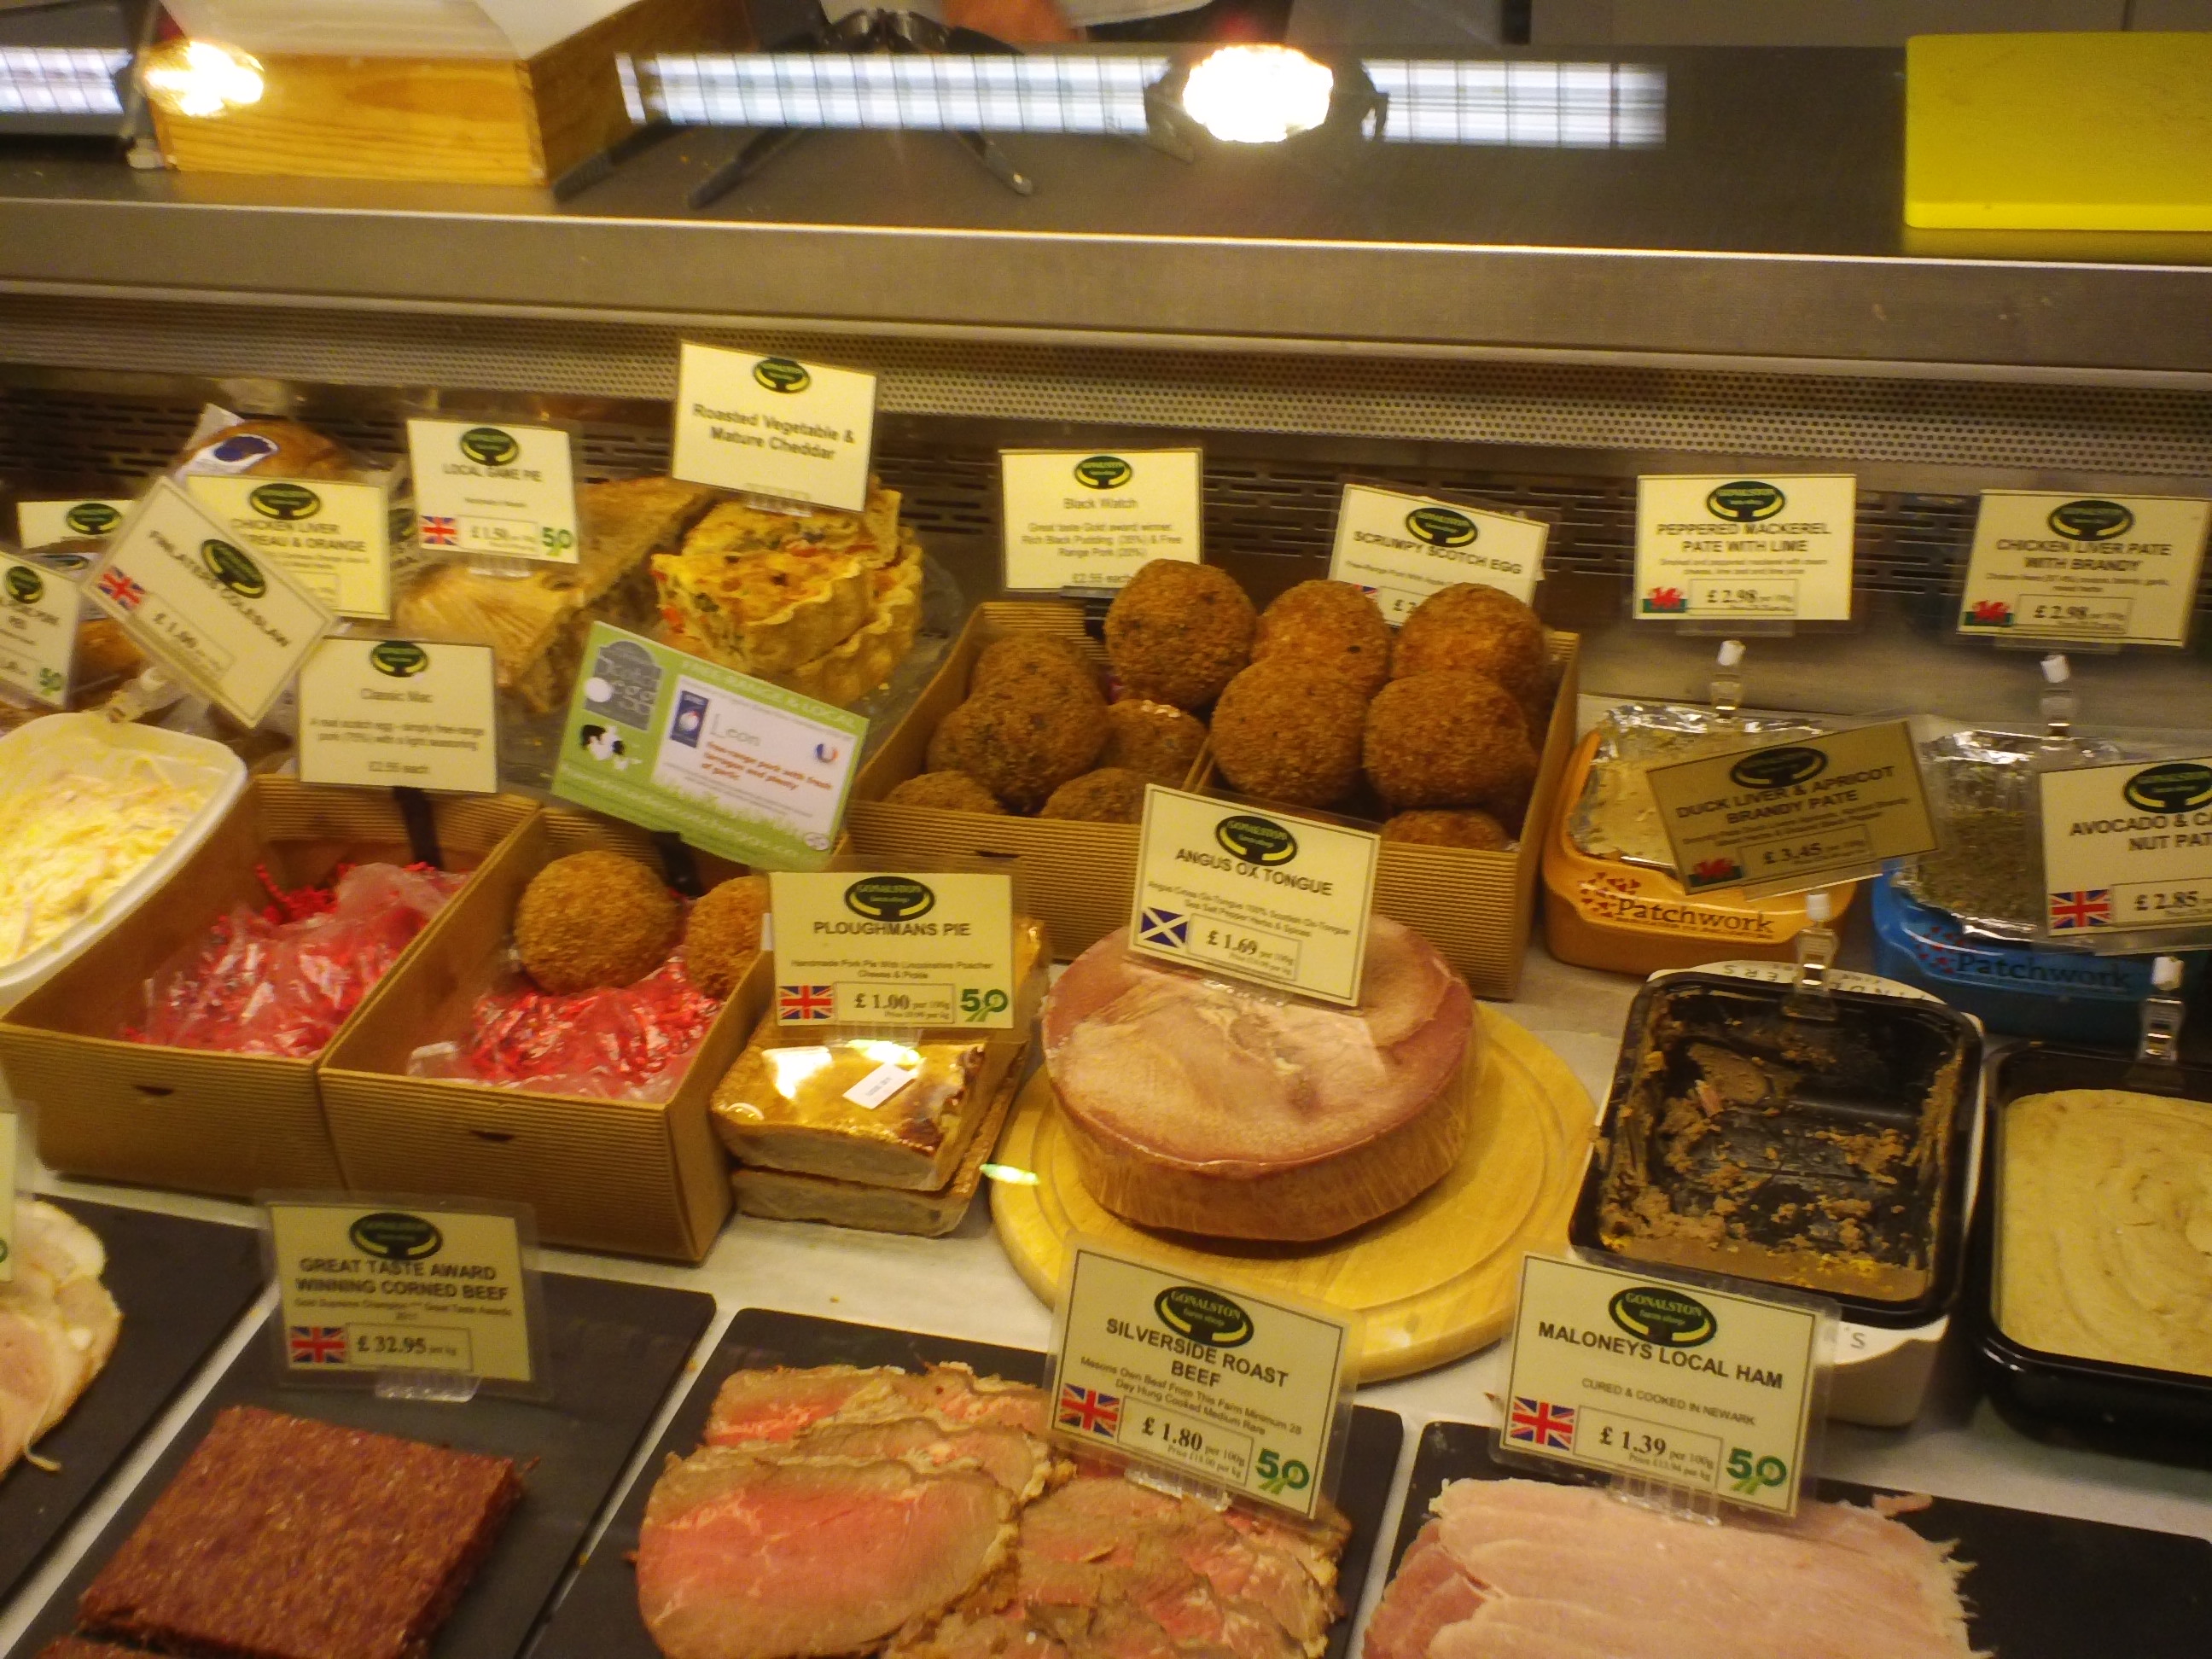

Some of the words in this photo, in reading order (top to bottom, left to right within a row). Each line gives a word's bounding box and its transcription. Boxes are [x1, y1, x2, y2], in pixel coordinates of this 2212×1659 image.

[694, 404, 759, 426] Roasted
[763, 415, 839, 440] Vegetable
[844, 429, 855, 443] &
[711, 426, 765, 447] Mature
[770, 436, 835, 459] Cheddar
[1064, 498, 1095, 509] Black
[1100, 498, 1138, 509] Watch
[1657, 523, 1740, 535] PEPPERED
[1744, 522, 1831, 535] MACKEREL
[1353, 531, 1423, 554] SCRUMPY
[1428, 544, 1488, 568] SCOTCH
[1490, 558, 1523, 574] EGG
[1681, 540, 1722, 552] PATE
[1726, 540, 1767, 552] WITH
[1770, 540, 1808, 551] LIME
[1996, 539, 2070, 552] CHICKEN
[2074, 542, 2124, 555] LIVER
[2127, 544, 2173, 556] PATE
[2024, 557, 2068, 569] WITH
[2070, 559, 2144, 571] BRANDY
[1675, 798, 1731, 818] DUCK
[1732, 787, 1791, 806] LIVER
[1795, 783, 1807, 795] &
[1812, 766, 1895, 792] APRICOT
[1726, 801, 1802, 824] BRANDY
[1808, 789, 1858, 810] PATE
[2070, 816, 2167, 836] AVOCADO
[2174, 813, 2188, 827] &
[2128, 835, 2170, 851] NUT
[1176, 848, 1231, 872] ANGUS
[1237, 862, 1260, 878] OX
[1263, 865, 1333, 896] TONGUE
[812, 922, 937, 936] PLOUGHMANS
[943, 923, 972, 936] PIE
[1616, 898, 1774, 934] Patchwork
[1208, 930, 1220, 946] £
[1224, 934, 1258, 955] 1.69
[1957, 952, 2130, 989] Patchwork
[854, 992, 866, 1009] £
[299, 1257, 361, 1274] GREAT
[366, 1260, 423, 1277] TASTE
[430, 1264, 497, 1281] AWARD
[294, 1278, 375, 1294] WINNING
[381, 1281, 457, 1298] CORNED
[463, 1285, 509, 1301] BEEF
[1170, 1290, 1242, 1319] GONALSTON
[1624, 1292, 1703, 1318] GONALSTON
[358, 1336, 370, 1352] £
[375, 1336, 426, 1353] 32.95
[1106, 1318, 1217, 1365] SILVERSIDE
[1223, 1353, 1289, 1388] ROAST
[1538, 1321, 1653, 1360] MALONEYS
[1659, 1345, 1729, 1377] LOCAL
[1735, 1364, 1783, 1389] HAM
[1171, 1360, 1221, 1388] BEEF
[1115, 1378, 1135, 1394] Day
[1138, 1385, 1162, 1401] Hung
[1168, 1382, 1194, 1398] From
[1218, 1398, 1243, 1414] Farm
[1581, 1378, 1622, 1395] CURED
[1625, 1388, 1633, 1398] &
[1636, 1390, 1685, 1409] COOKED
[1689, 1402, 1700, 1413] IN
[1703, 1406, 1755, 1426] NEWARK
[1142, 1417, 1155, 1436] £
[1162, 1423, 1203, 1451] 1.80
[1599, 1426, 1614, 1445] £
[1622, 1430, 1666, 1456] 1.39
